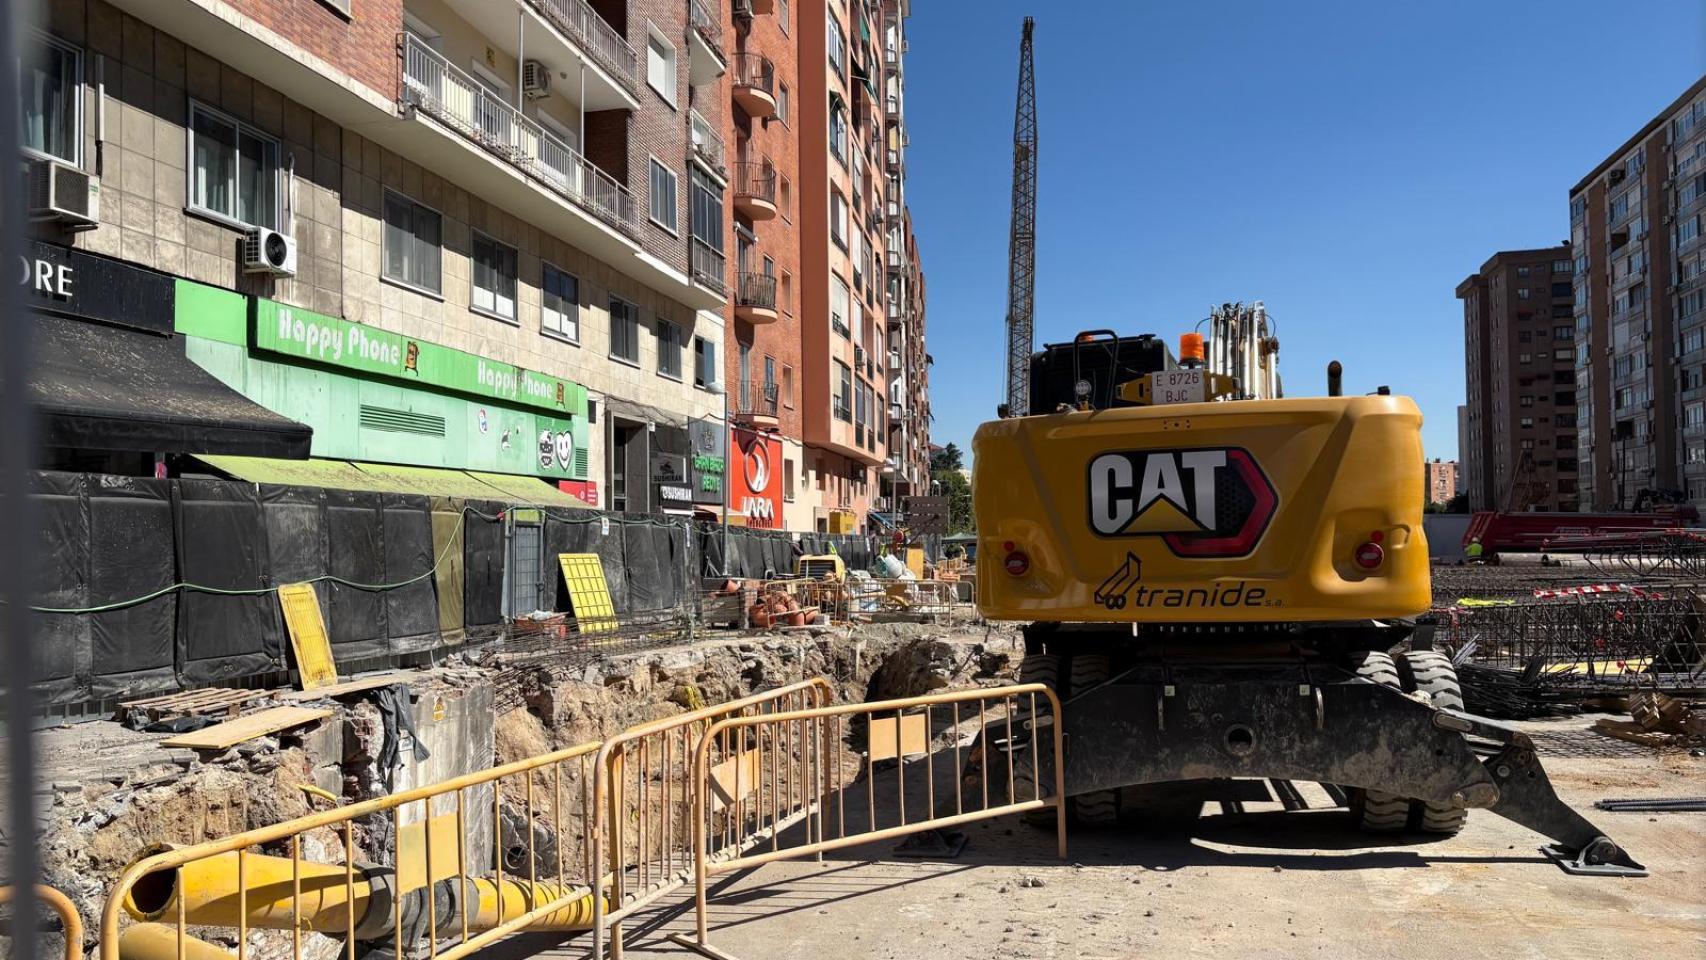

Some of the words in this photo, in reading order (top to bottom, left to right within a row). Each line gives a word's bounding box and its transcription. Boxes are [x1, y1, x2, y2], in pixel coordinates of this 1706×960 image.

[278, 307, 343, 361] Happy
[347, 325, 400, 366] Phone
[477, 359, 518, 398] Happy
[1156, 374, 1163, 387] E
[1169, 372, 1199, 386] 8726
[1166, 390, 1188, 402] BJC
[1090, 450, 1226, 534] CAT
[742, 496, 774, 519] LARA
[1136, 580, 1266, 608] tranide
